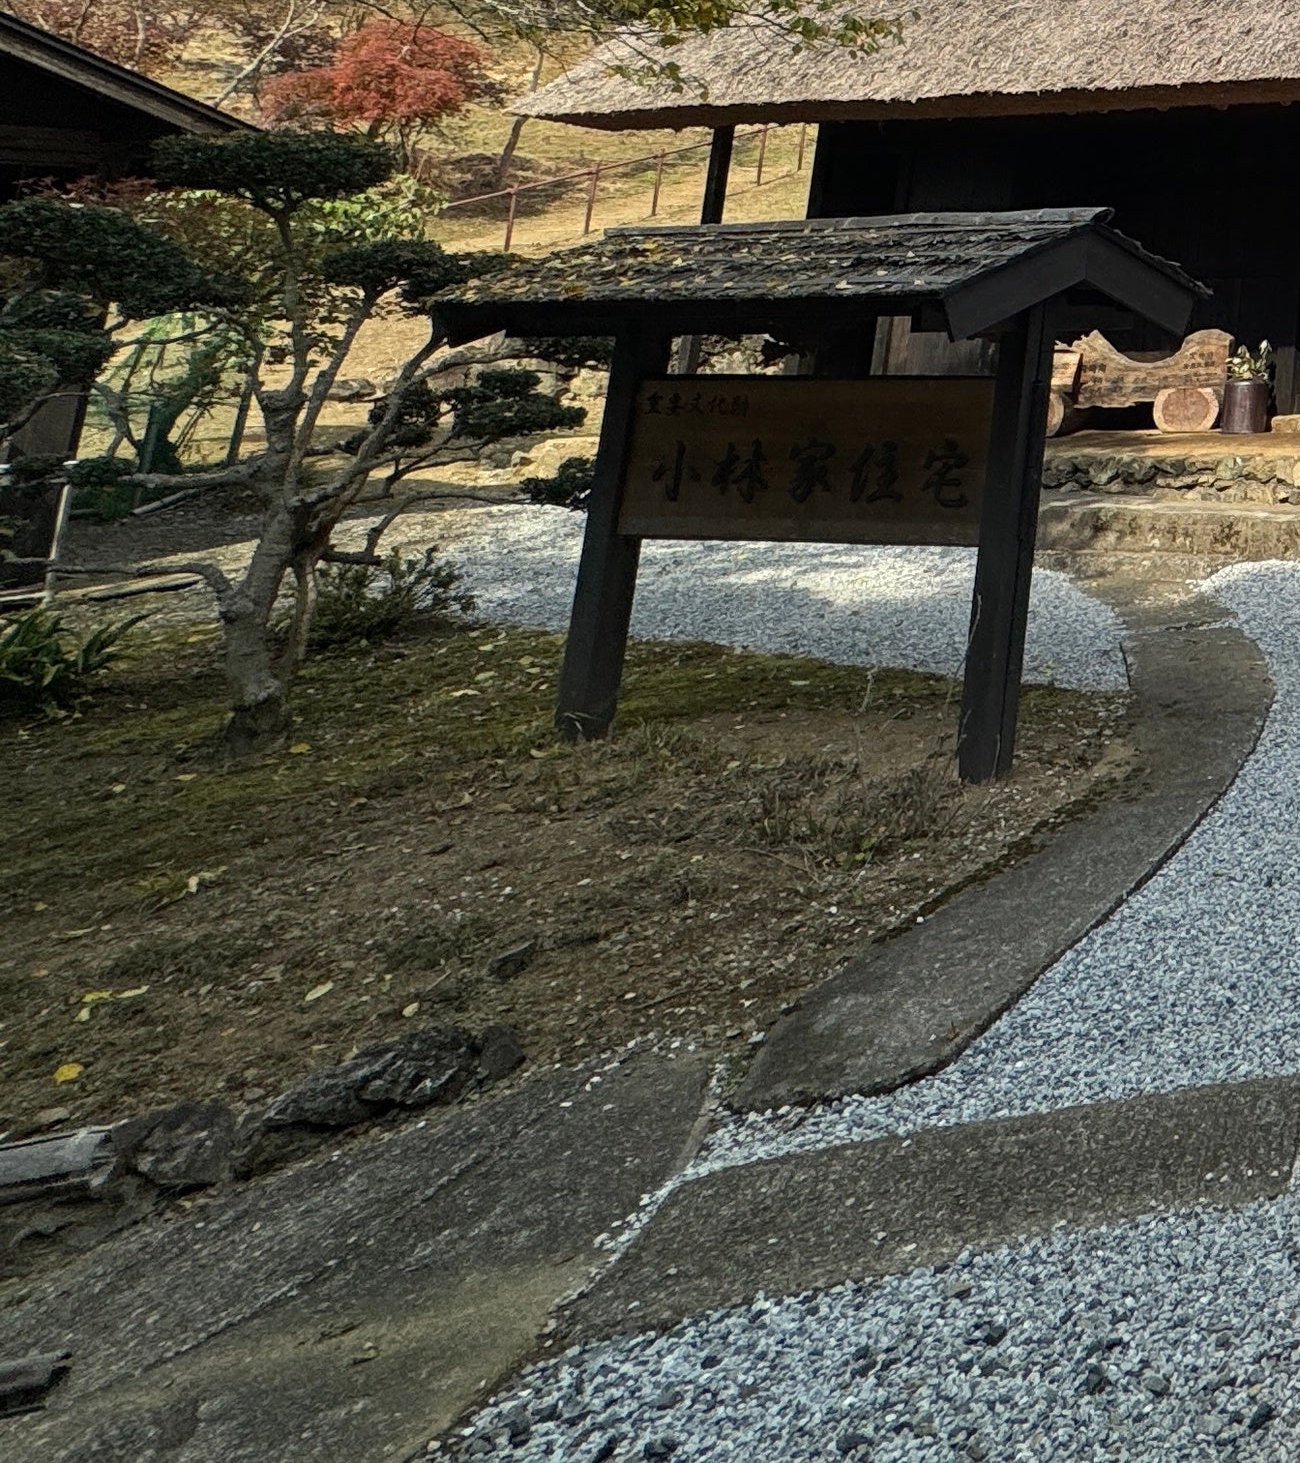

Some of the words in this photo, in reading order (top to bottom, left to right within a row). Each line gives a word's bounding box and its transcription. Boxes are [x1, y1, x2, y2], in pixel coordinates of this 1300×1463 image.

[643, 392, 750, 418] 重要文化財
[652, 438, 970, 508] 小林家住宅
